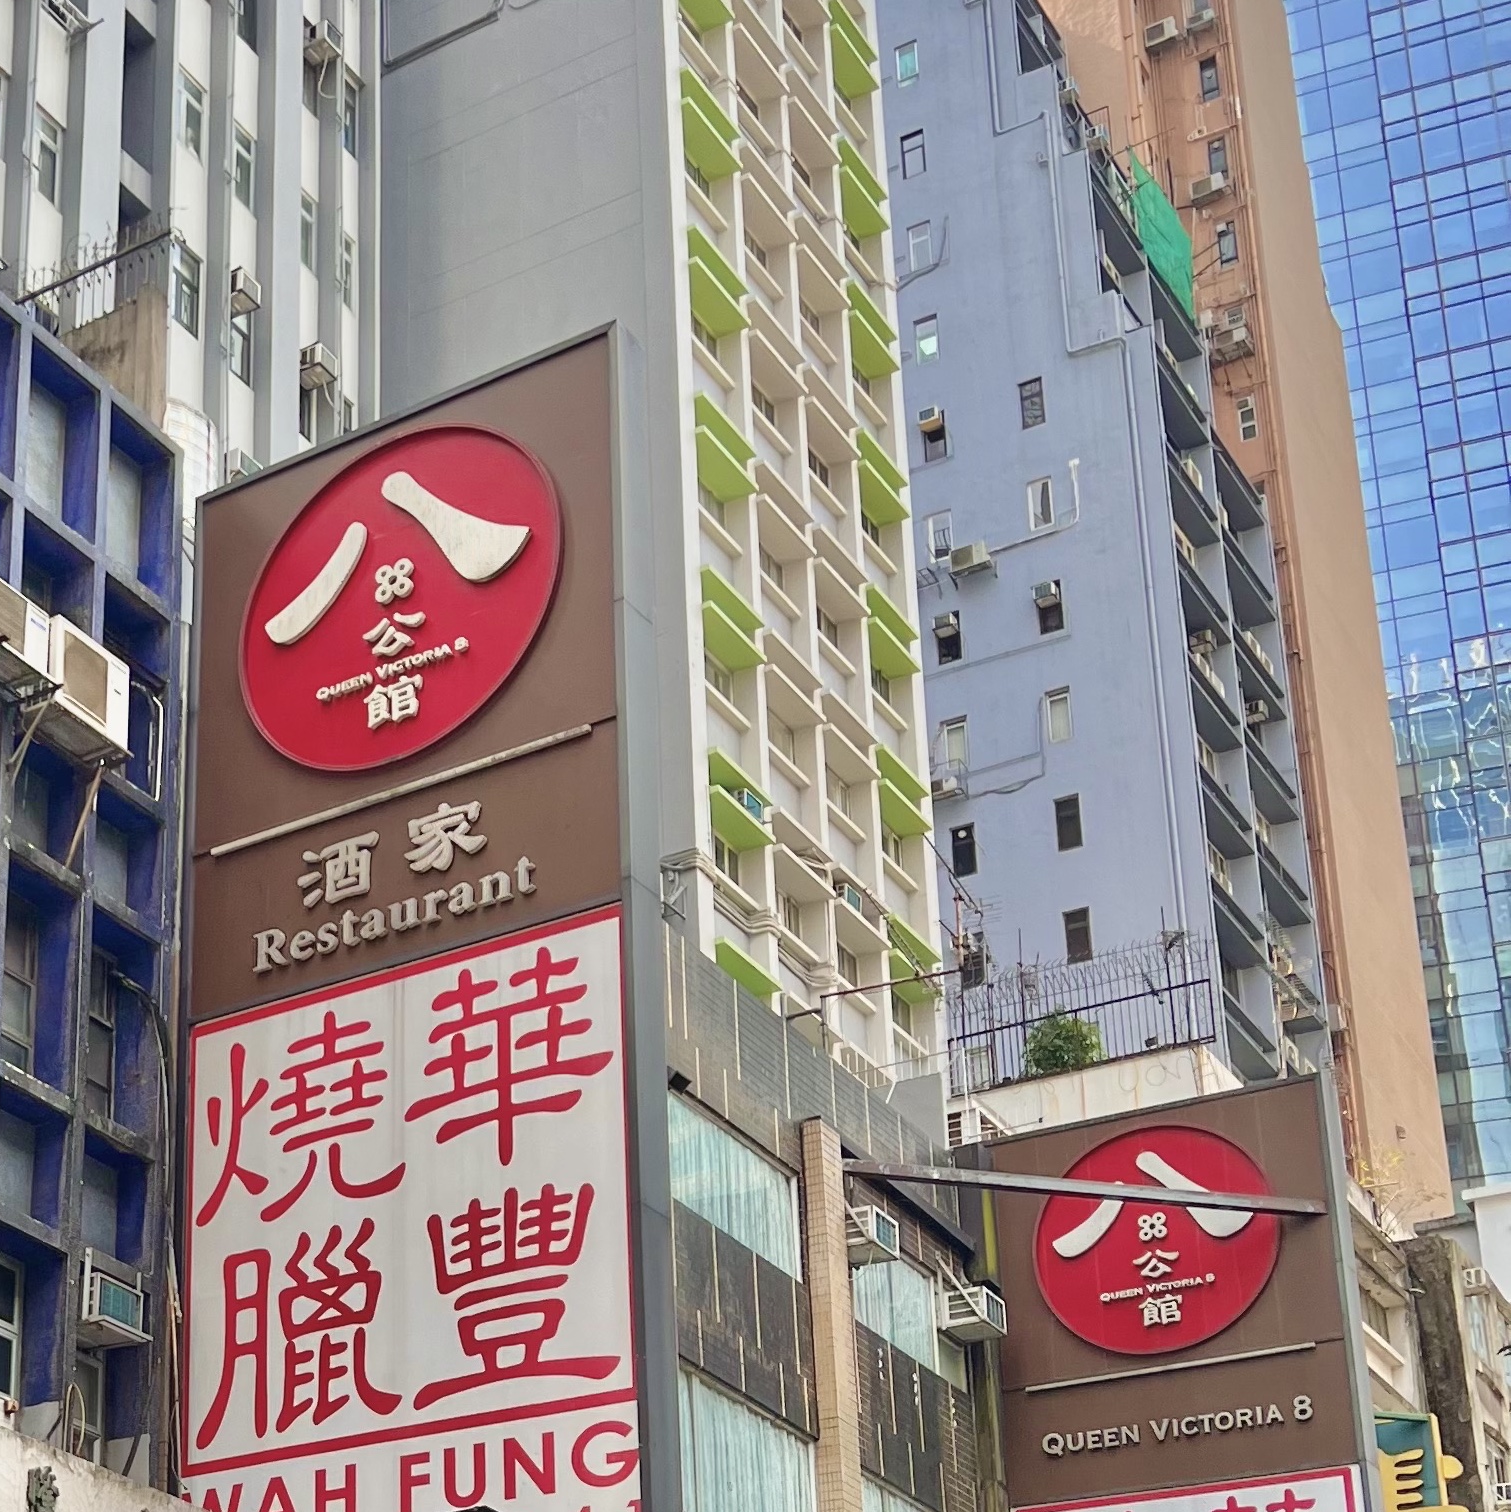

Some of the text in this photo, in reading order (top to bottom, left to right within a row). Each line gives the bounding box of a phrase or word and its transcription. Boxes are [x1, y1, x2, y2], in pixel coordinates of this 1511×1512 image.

[362, 611, 426, 656] 公
[315, 672, 373, 701] QUEEN
[375, 641, 452, 680] VICTORIA
[362, 674, 424, 730] 館
[297, 801, 487, 909] 酒家
[252, 856, 537, 973] Restaurant
[404, 946, 621, 1411] 華豐
[196, 1011, 406, 1450] 燒臘
[1099, 1287, 1144, 1304] QUEEN
[1145, 1276, 1204, 1298] VICTORIA
[1132, 1247, 1180, 1279] 公
[1138, 1294, 1183, 1328] 館
[1041, 1395, 1314, 1457] QUEEN VICTORIA 8
